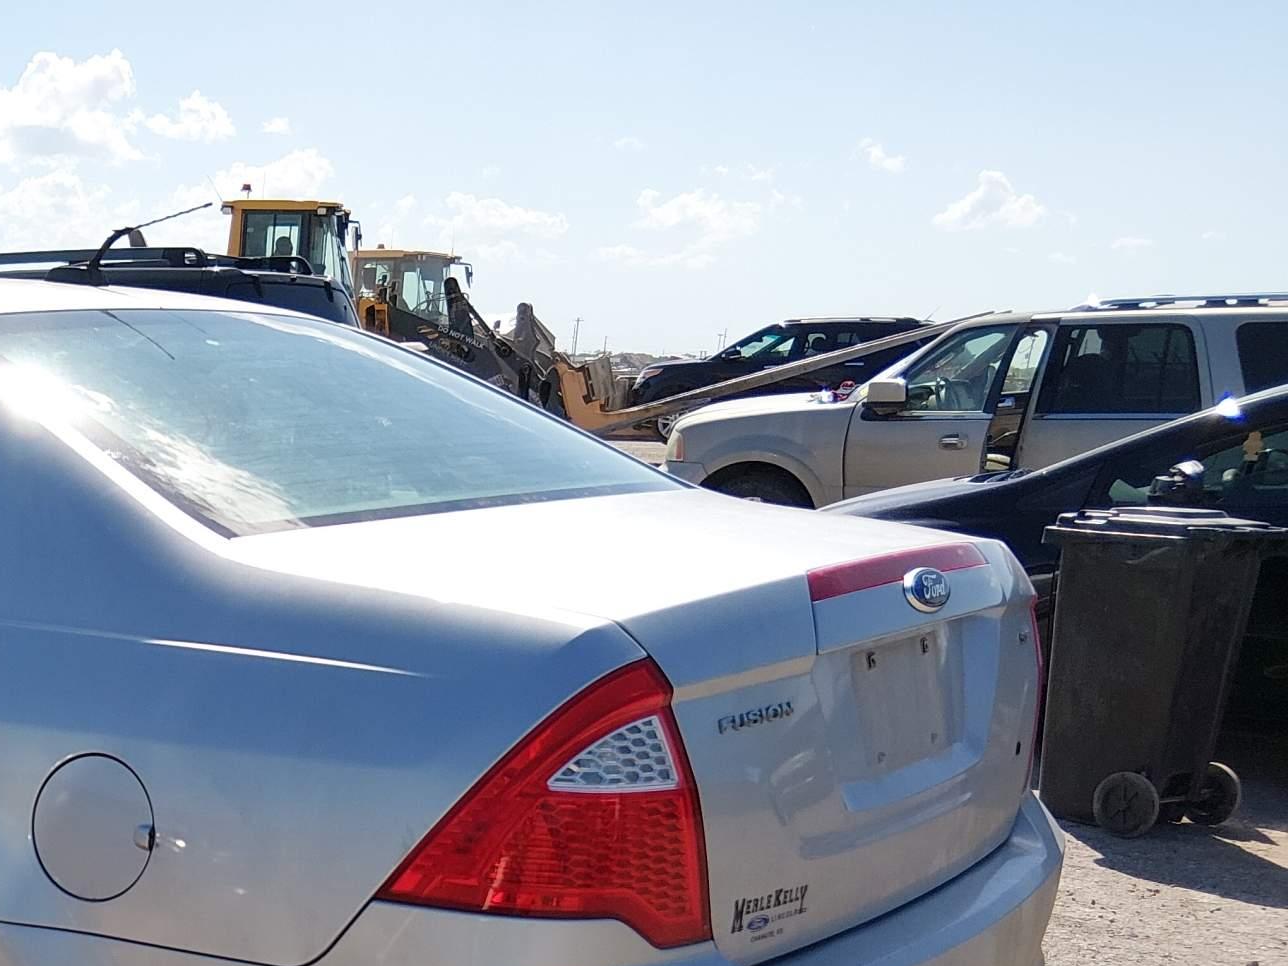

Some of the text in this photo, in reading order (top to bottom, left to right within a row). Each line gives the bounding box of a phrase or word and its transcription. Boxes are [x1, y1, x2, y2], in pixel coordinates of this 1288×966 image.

[437, 325, 486, 350] DO NOT WALK
[921, 574, 947, 600] Ford
[717, 701, 794, 735] FUSION
